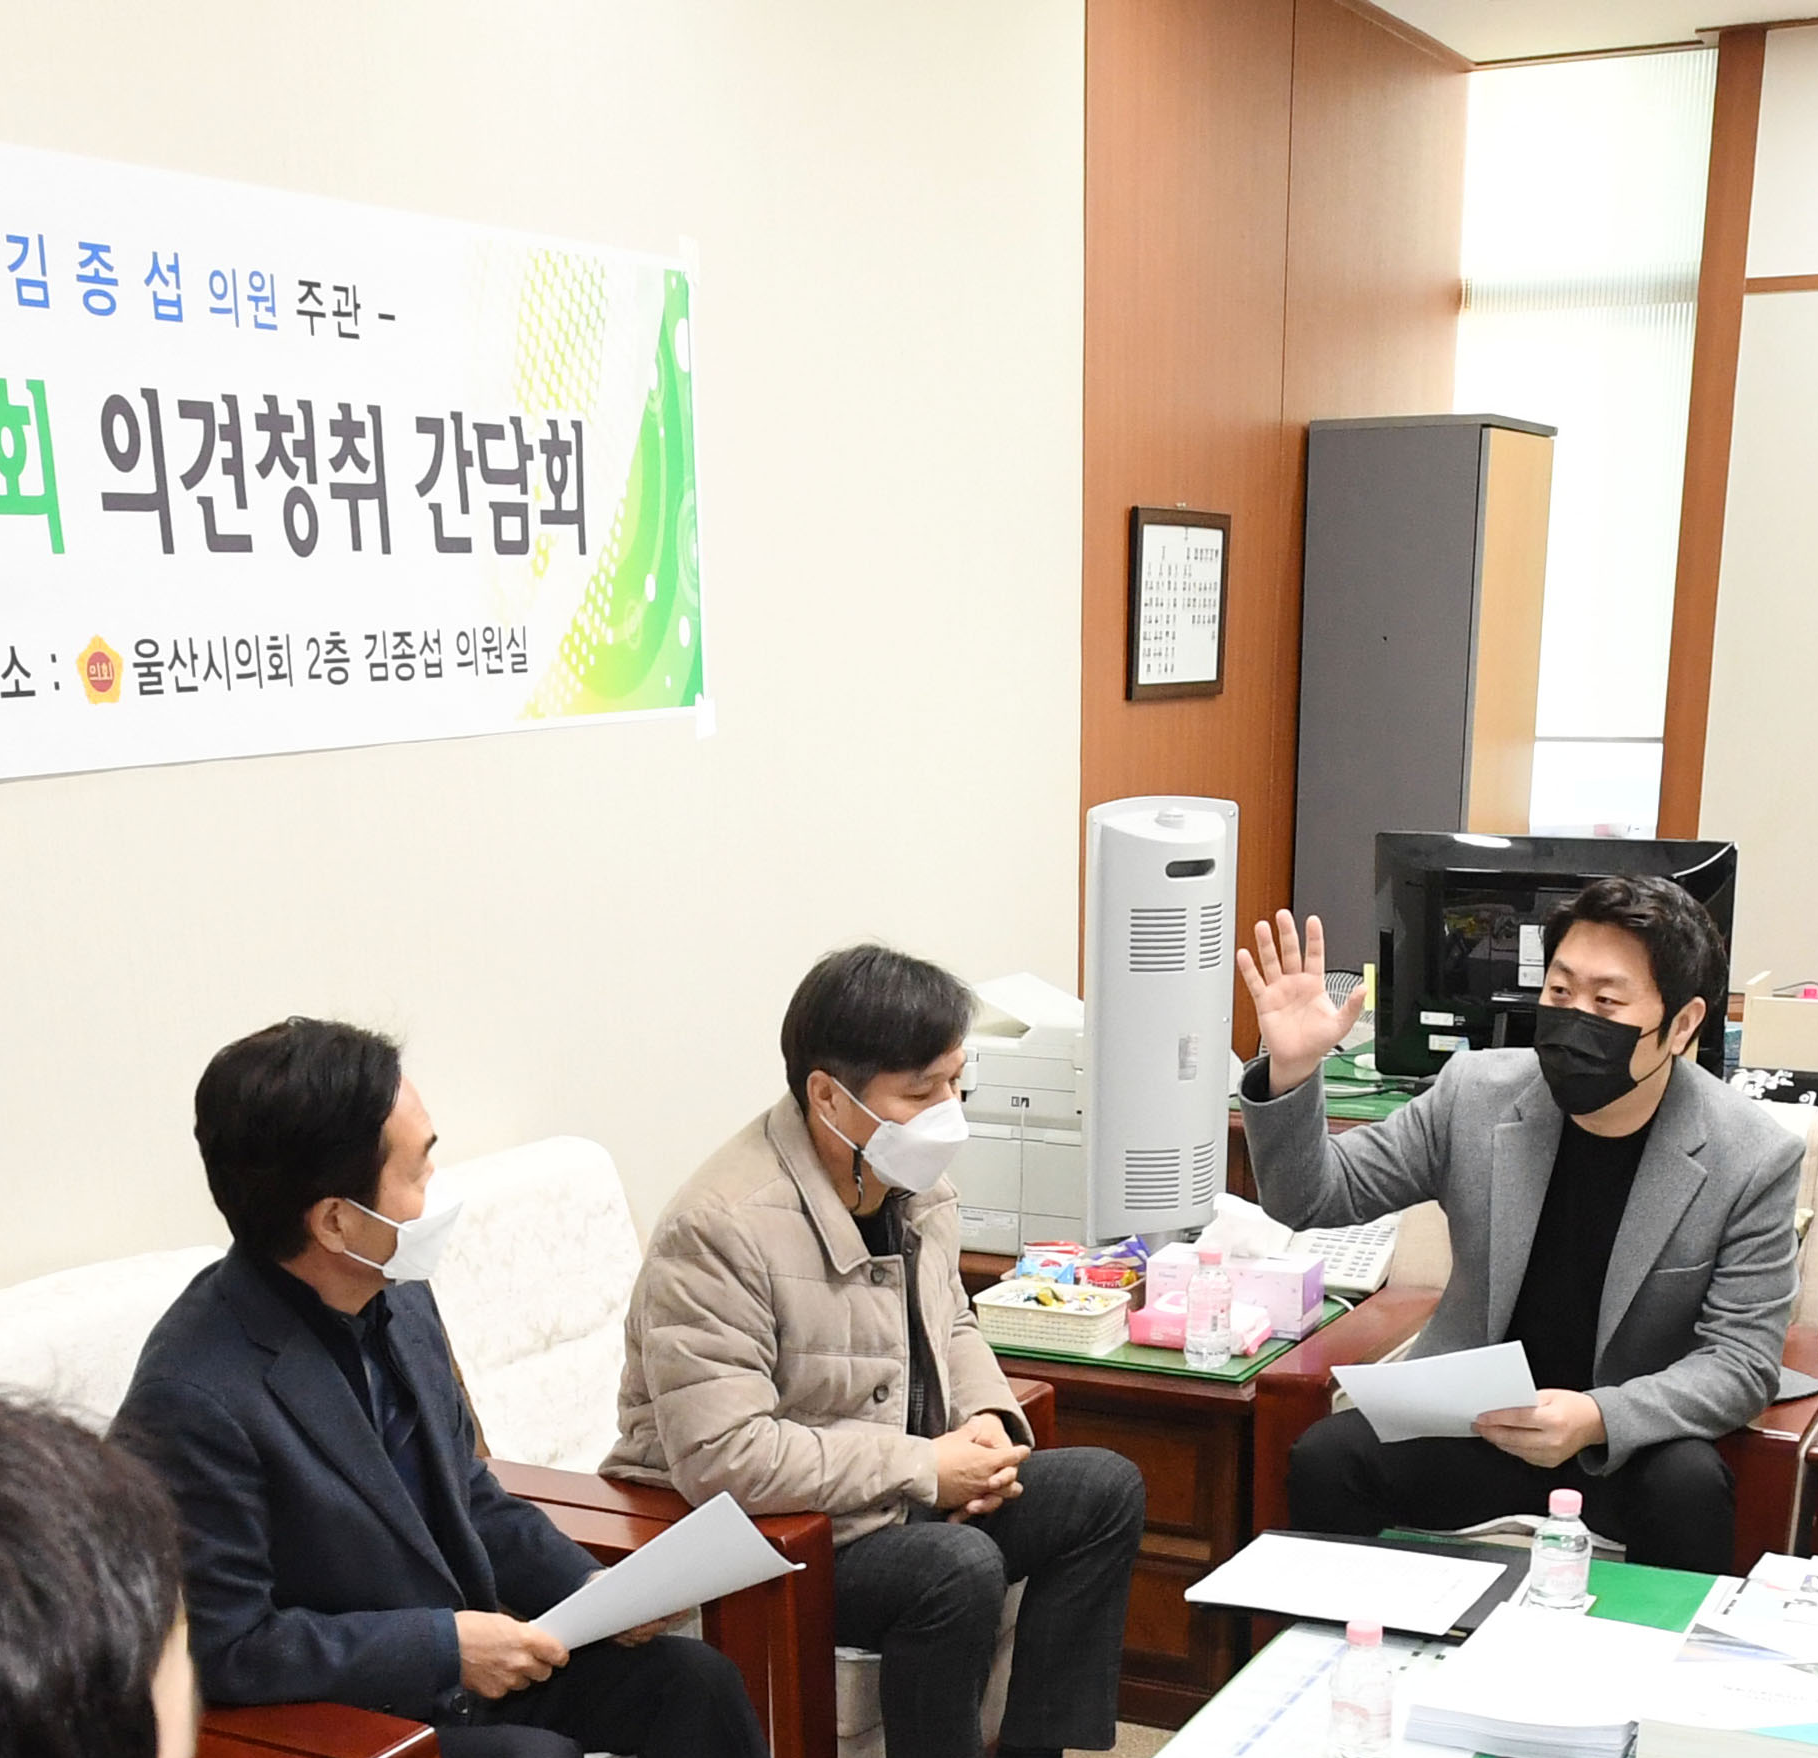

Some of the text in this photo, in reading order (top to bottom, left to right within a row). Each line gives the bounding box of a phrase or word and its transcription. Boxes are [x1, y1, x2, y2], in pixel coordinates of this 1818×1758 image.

[209, 269, 277, 330] 의원
[296, 280, 361, 339] 주관
[101, 388, 391, 557] 의견청취
[416, 406, 586, 556] 간담회
[133, 626, 528, 695] 울산시의회 2층 김종섭 의원실
